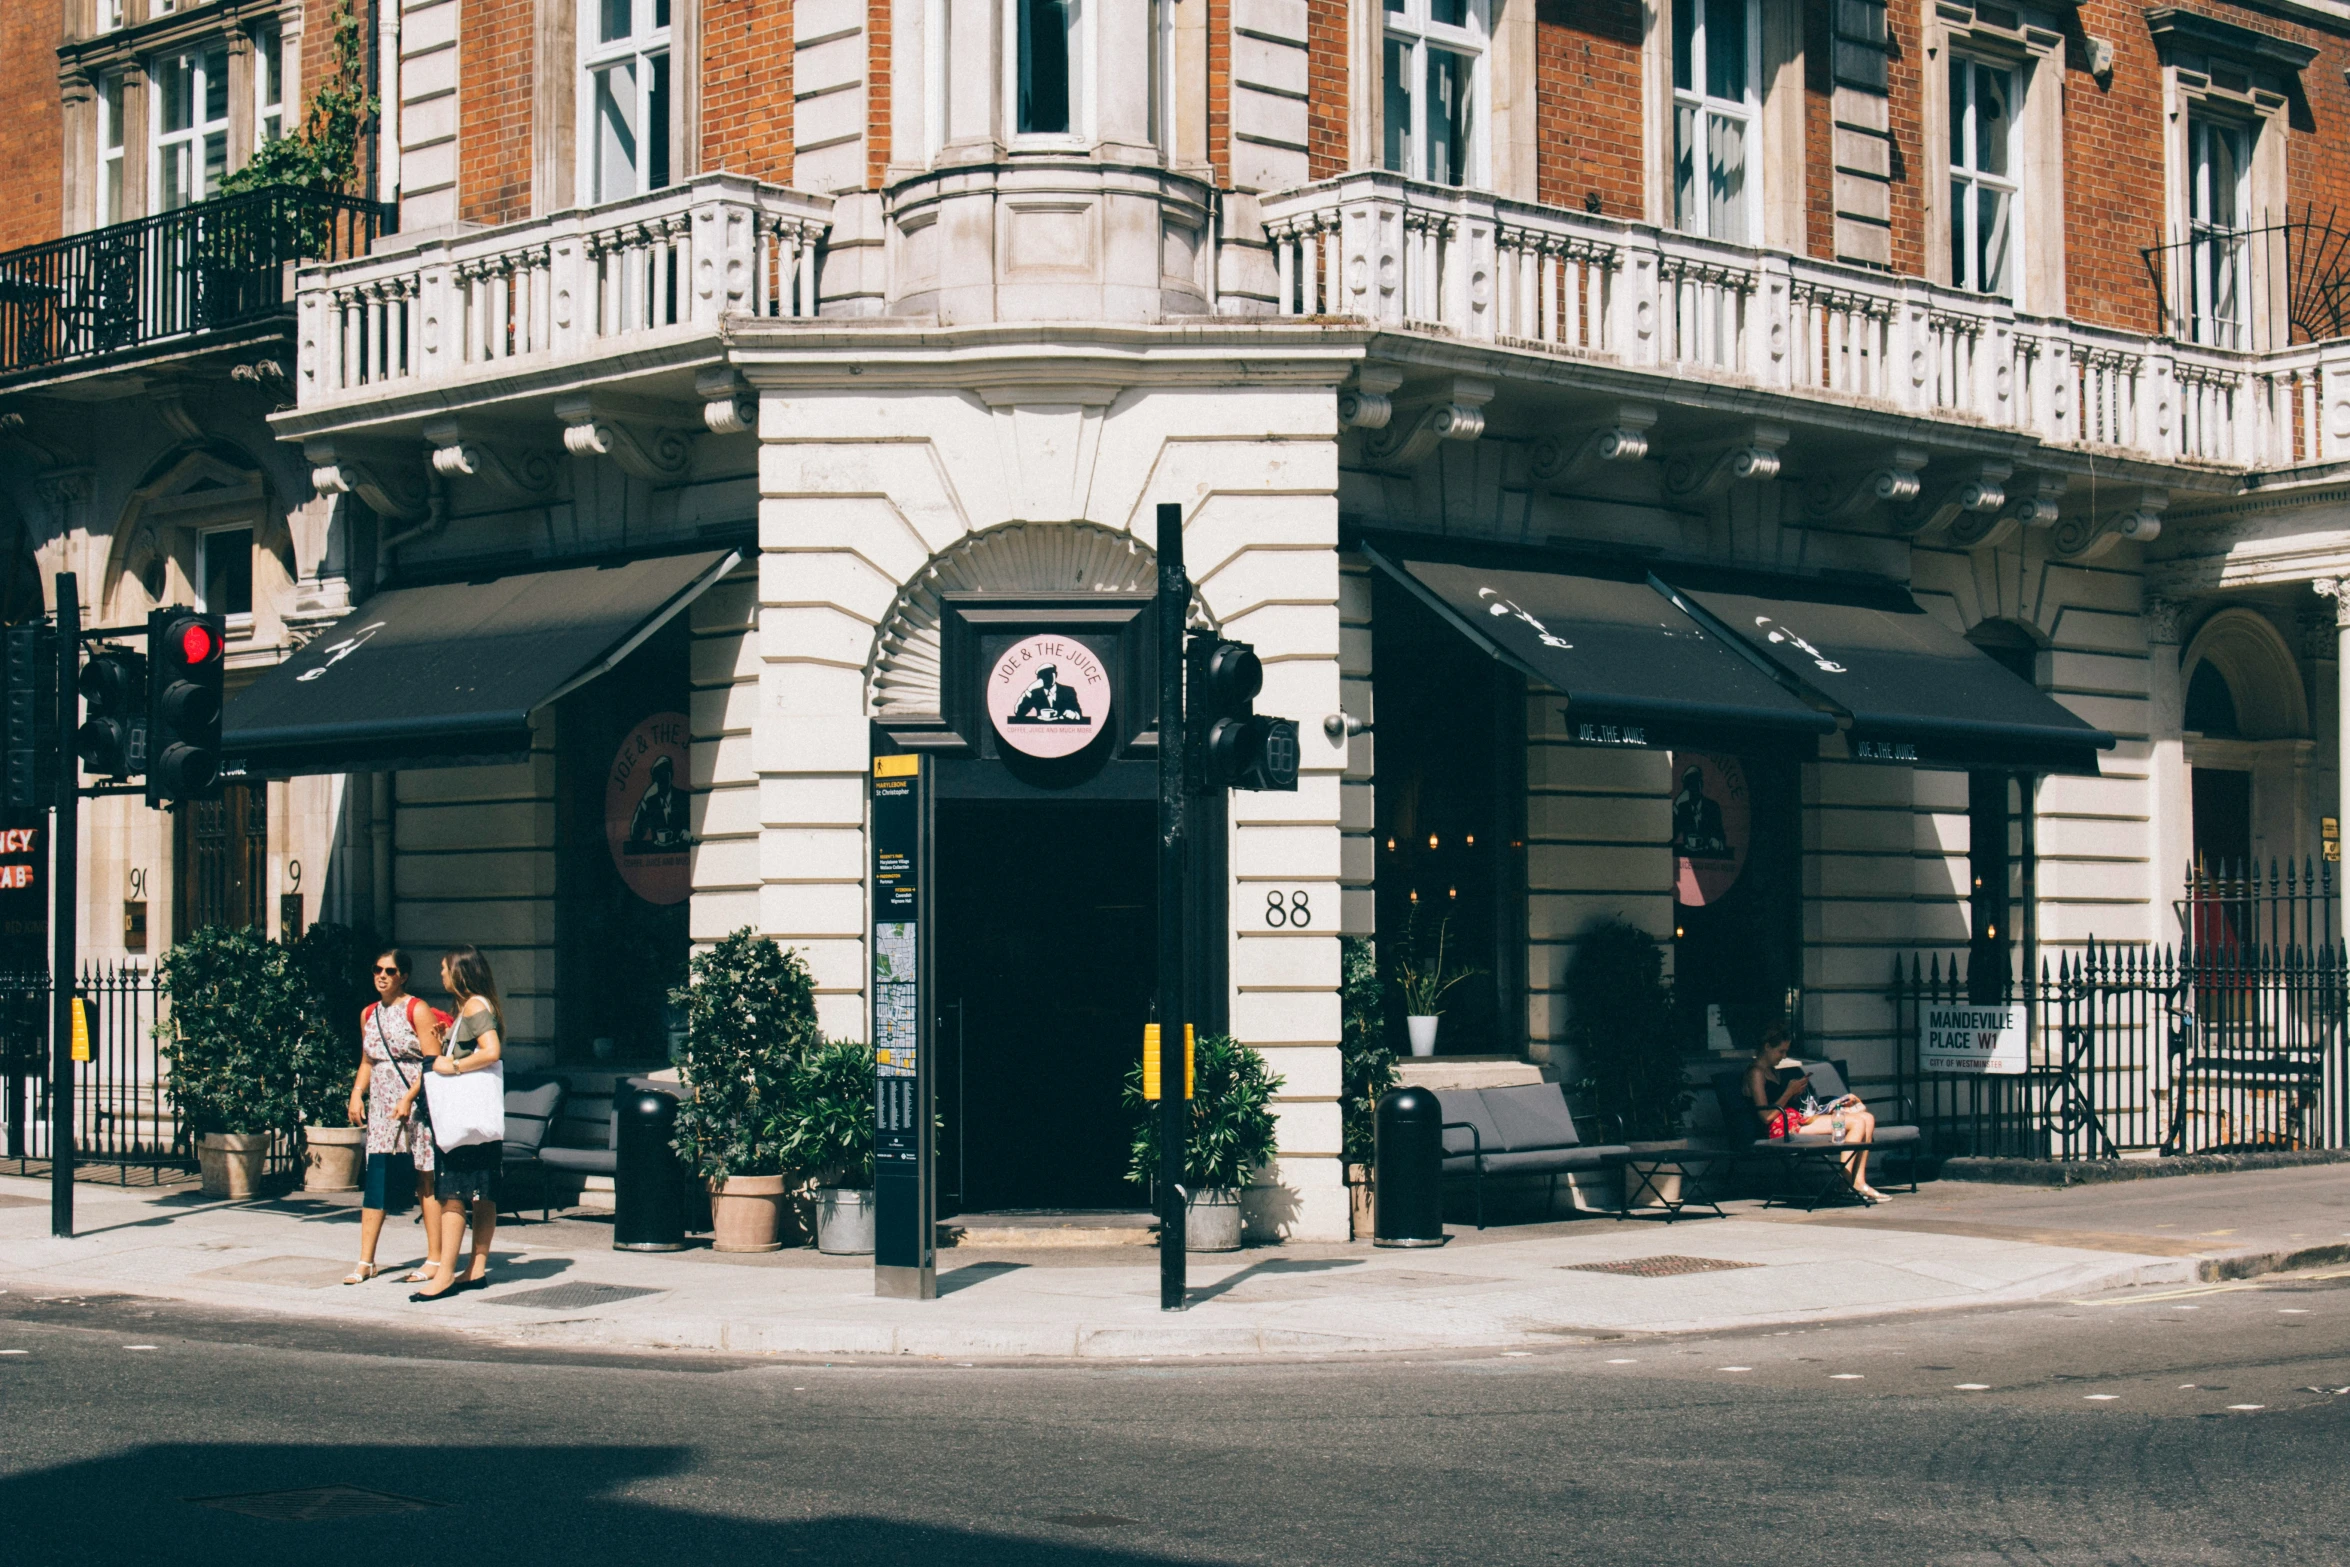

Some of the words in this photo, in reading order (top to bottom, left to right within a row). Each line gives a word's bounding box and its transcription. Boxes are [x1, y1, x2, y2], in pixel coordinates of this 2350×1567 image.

[998, 656, 1021, 684] JOE
[1020, 648, 1033, 661] &
[1035, 643, 1065, 656] THE
[1066, 650, 1102, 685] JUICE
[1579, 724, 1596, 741] JOE
[1601, 725, 1620, 743] THE
[1622, 727, 1647, 745] JUICE
[613, 746, 637, 792] JOE
[635, 734, 649, 754] &
[651, 723, 681, 745] THE
[1858, 741, 1873, 757] JOE
[1877, 742, 1893, 759] THE
[1895, 744, 1918, 760] JUICE
[227, 758, 247, 776] JUICE
[876, 780, 907, 788] MARYLEBONE
[881, 788, 910, 796] Christopher
[1266, 890, 1311, 928] 88
[1930, 1011, 2014, 1029] MANDEVILLE
[1930, 1031, 1971, 1049] PLACE
[1978, 1032, 1998, 1049] W1
[1929, 1058, 1945, 1067] CITY
[1946, 1059, 1955, 1067] OF
[1956, 1059, 2003, 1069] WESTMINSTER
